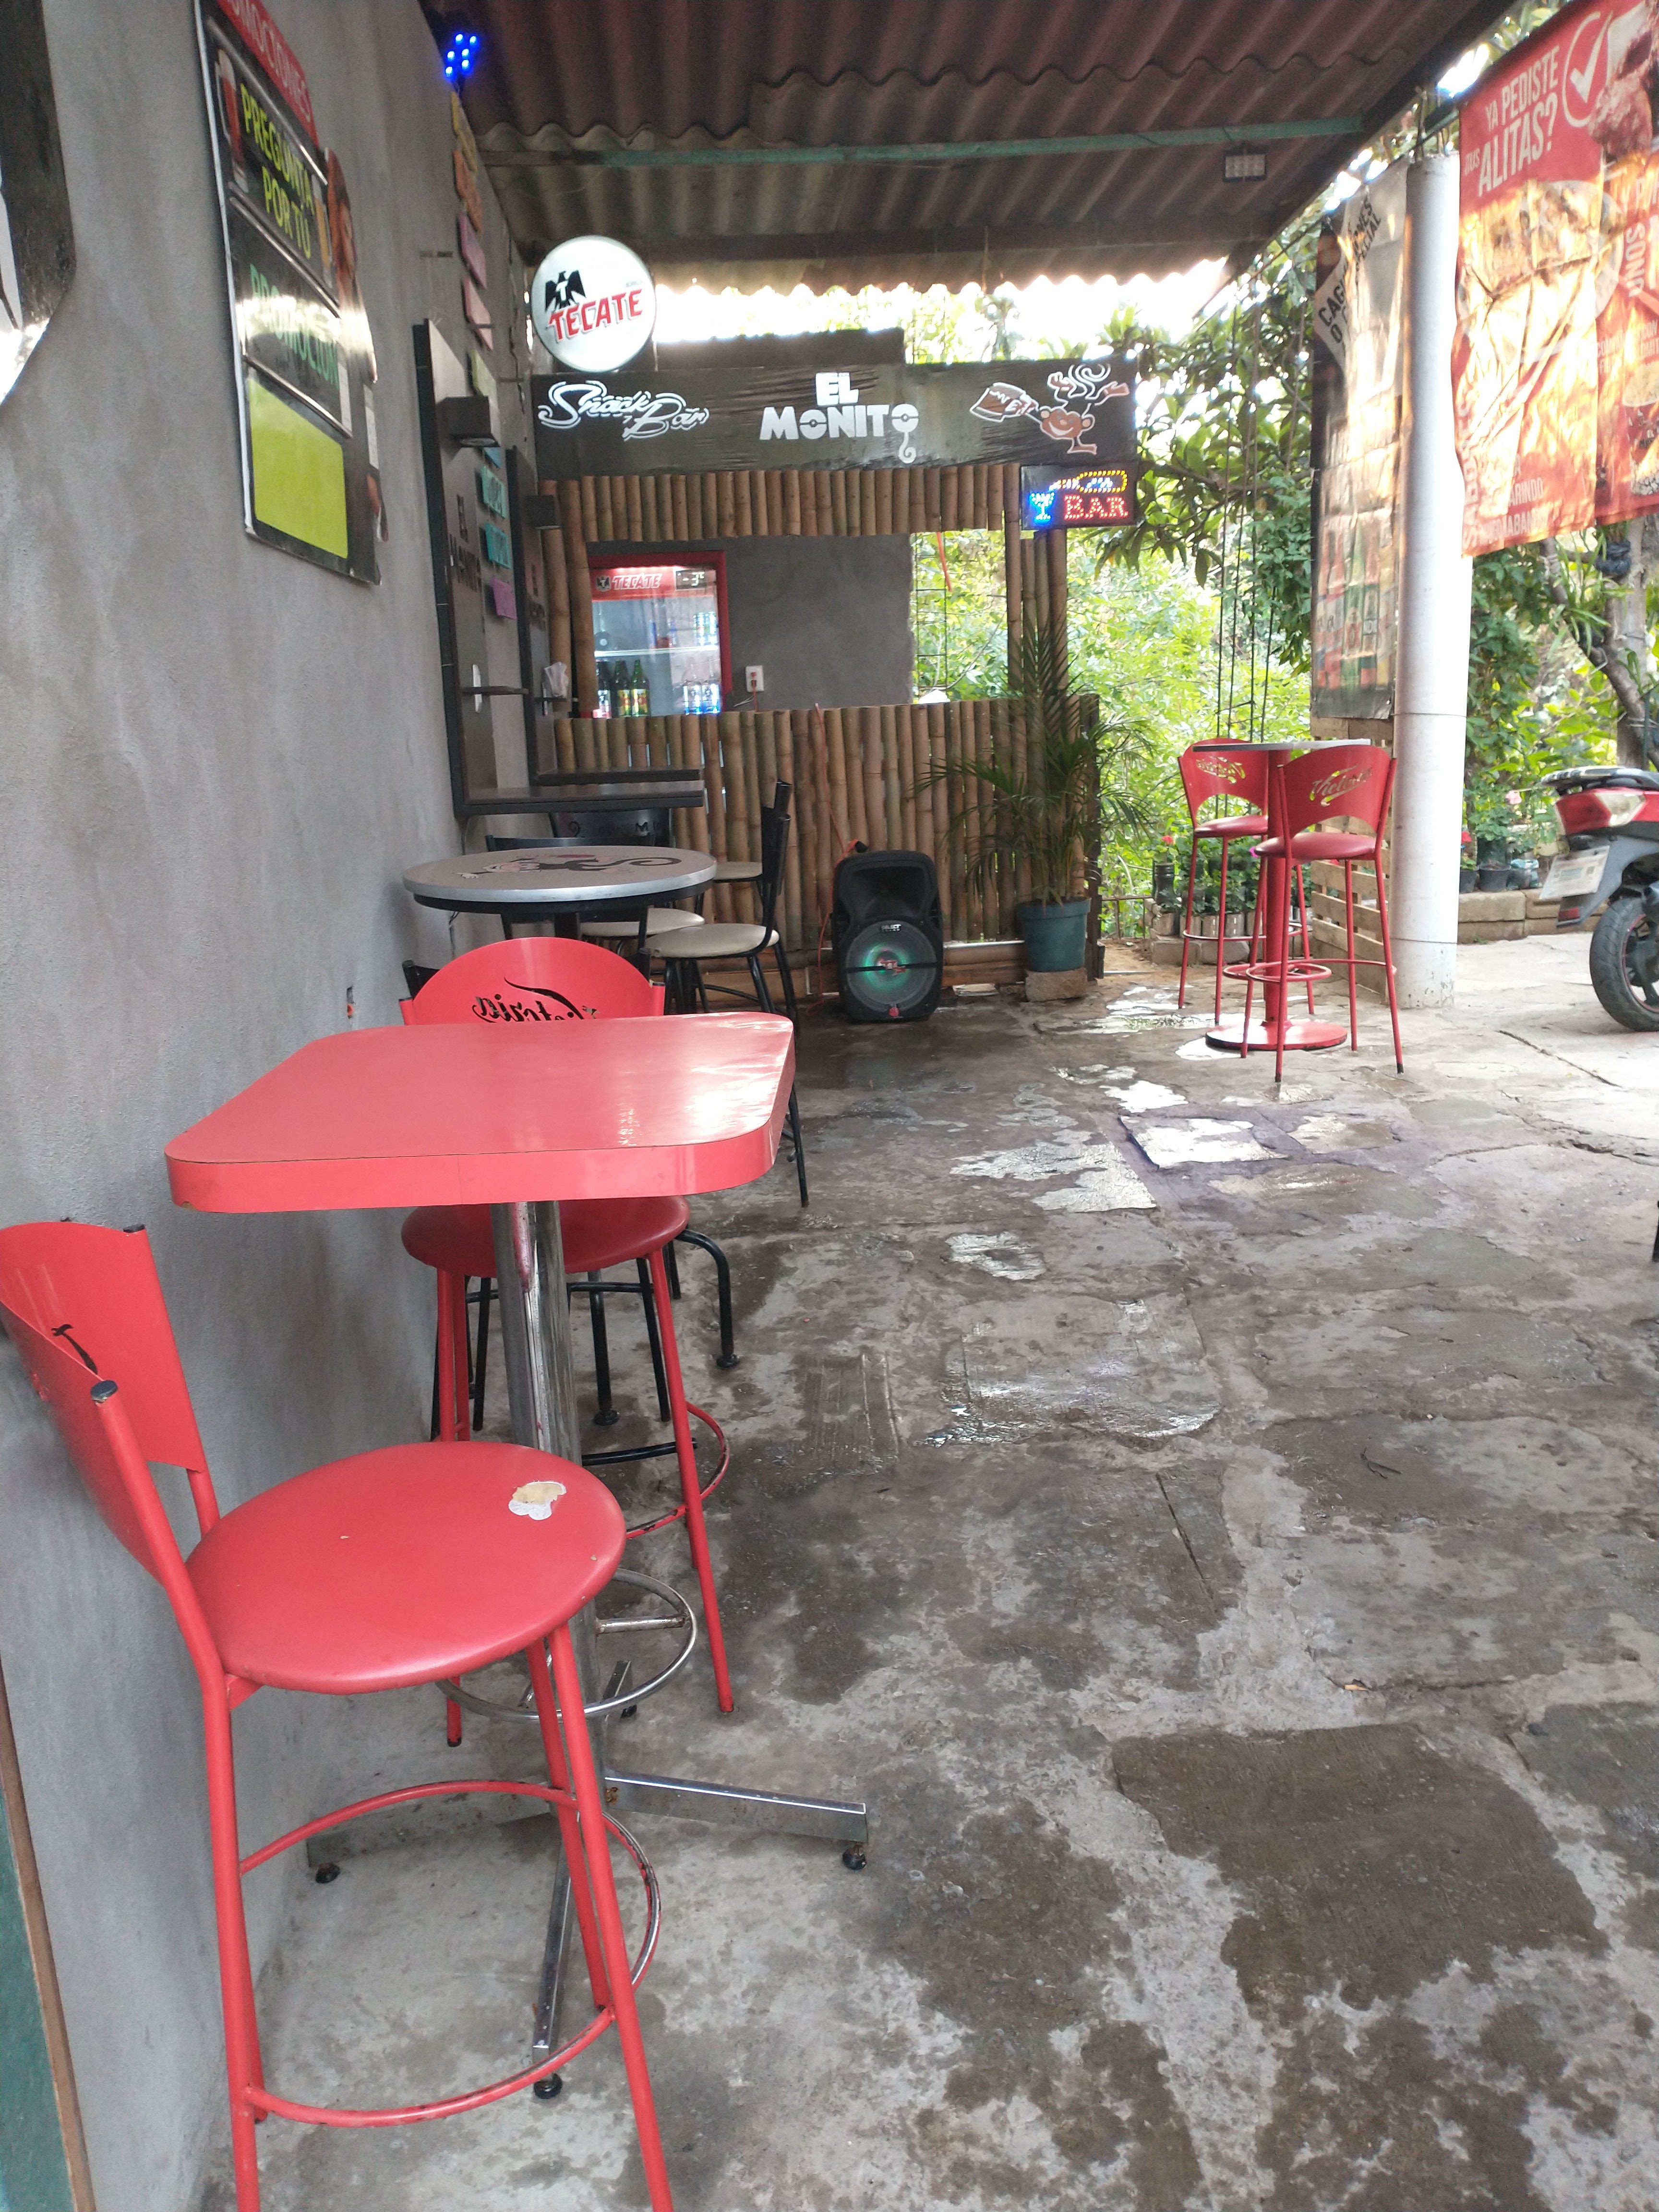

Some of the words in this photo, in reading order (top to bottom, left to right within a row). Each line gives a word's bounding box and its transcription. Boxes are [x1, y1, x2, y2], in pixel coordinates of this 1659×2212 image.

[1485, 99, 1499, 132] YA
[1501, 45, 1560, 126] PEDISTE
[240, 83, 315, 216] PREGUNTA
[1478, 91, 1559, 198] ALITAS?
[262, 166, 293, 236] POR
[291, 201, 312, 259] TU
[548, 288, 644, 342] TECATE
[538, 380, 651, 429] Snack
[622, 392, 710, 441] Bar
[815, 372, 860, 407] EL
[1064, 494, 1129, 520] BAR
[611, 573, 663, 590] TECATE
